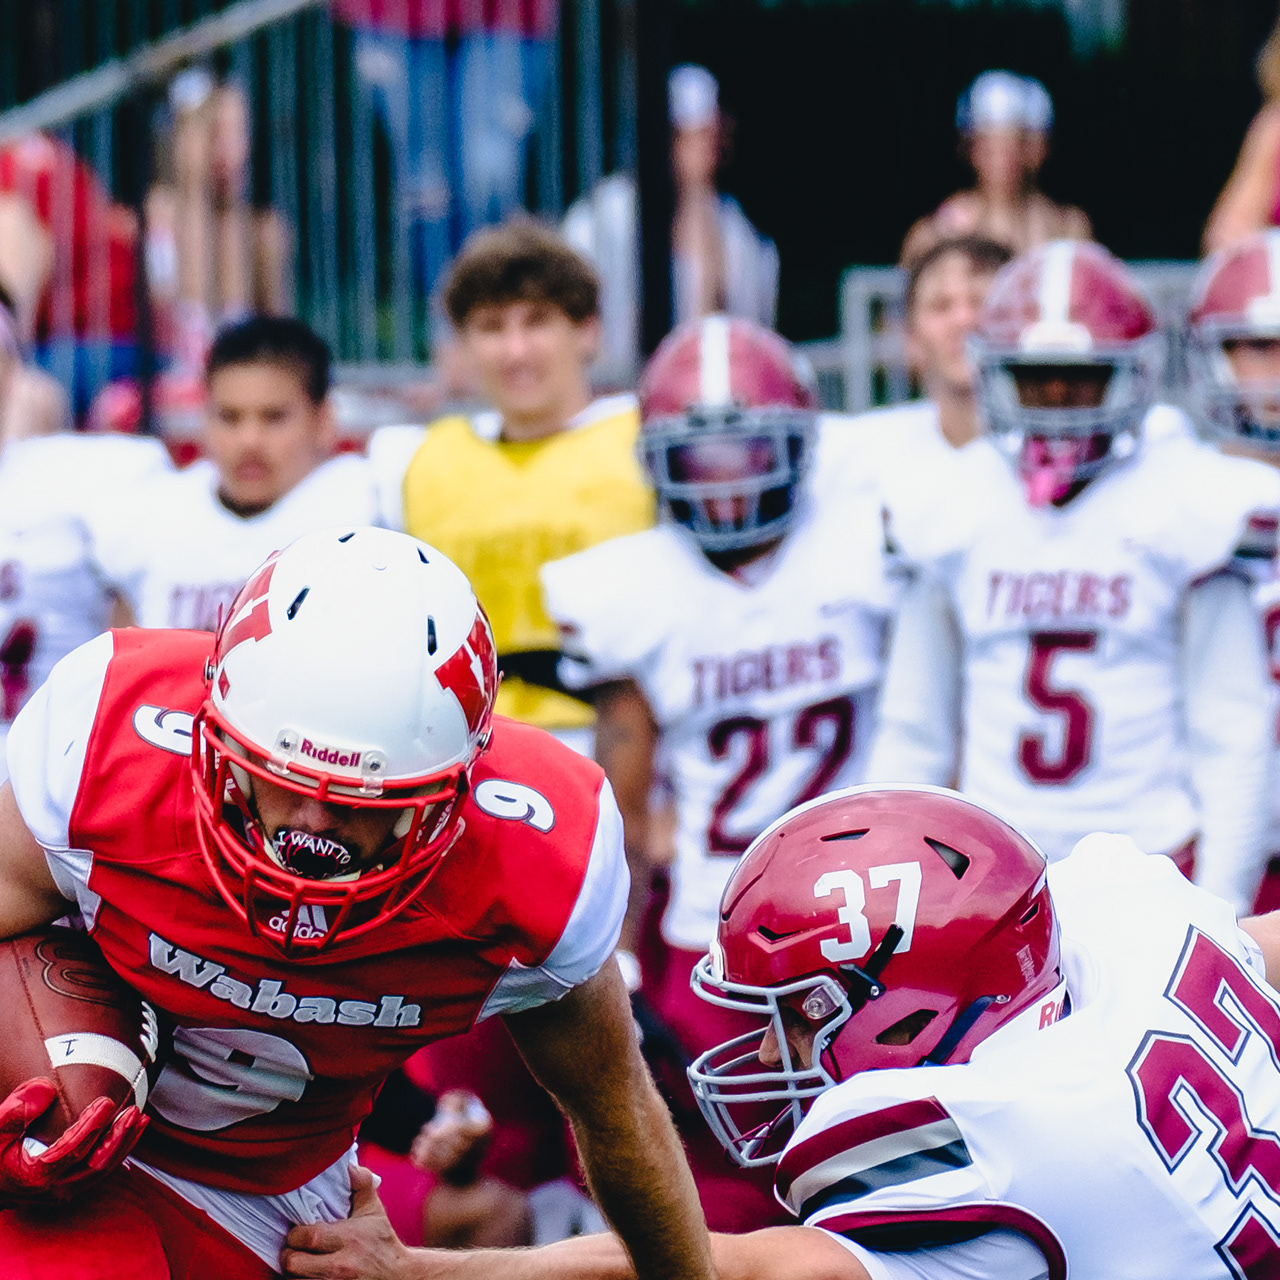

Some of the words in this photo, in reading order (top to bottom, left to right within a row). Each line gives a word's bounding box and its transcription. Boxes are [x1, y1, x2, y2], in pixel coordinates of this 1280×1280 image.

[987, 572, 1131, 620] TIGERS
[300, 739, 361, 768] Riddell
[1017, 628, 1096, 786] 5
[473, 779, 555, 833] 9
[706, 695, 854, 857] 22
[278, 831, 286, 846] I
[291, 832, 337, 856] WANT
[336, 845, 351, 865] TO
[813, 861, 922, 962] 37
[148, 932, 422, 1028] Wabash
[148, 1024, 315, 1131] 9
